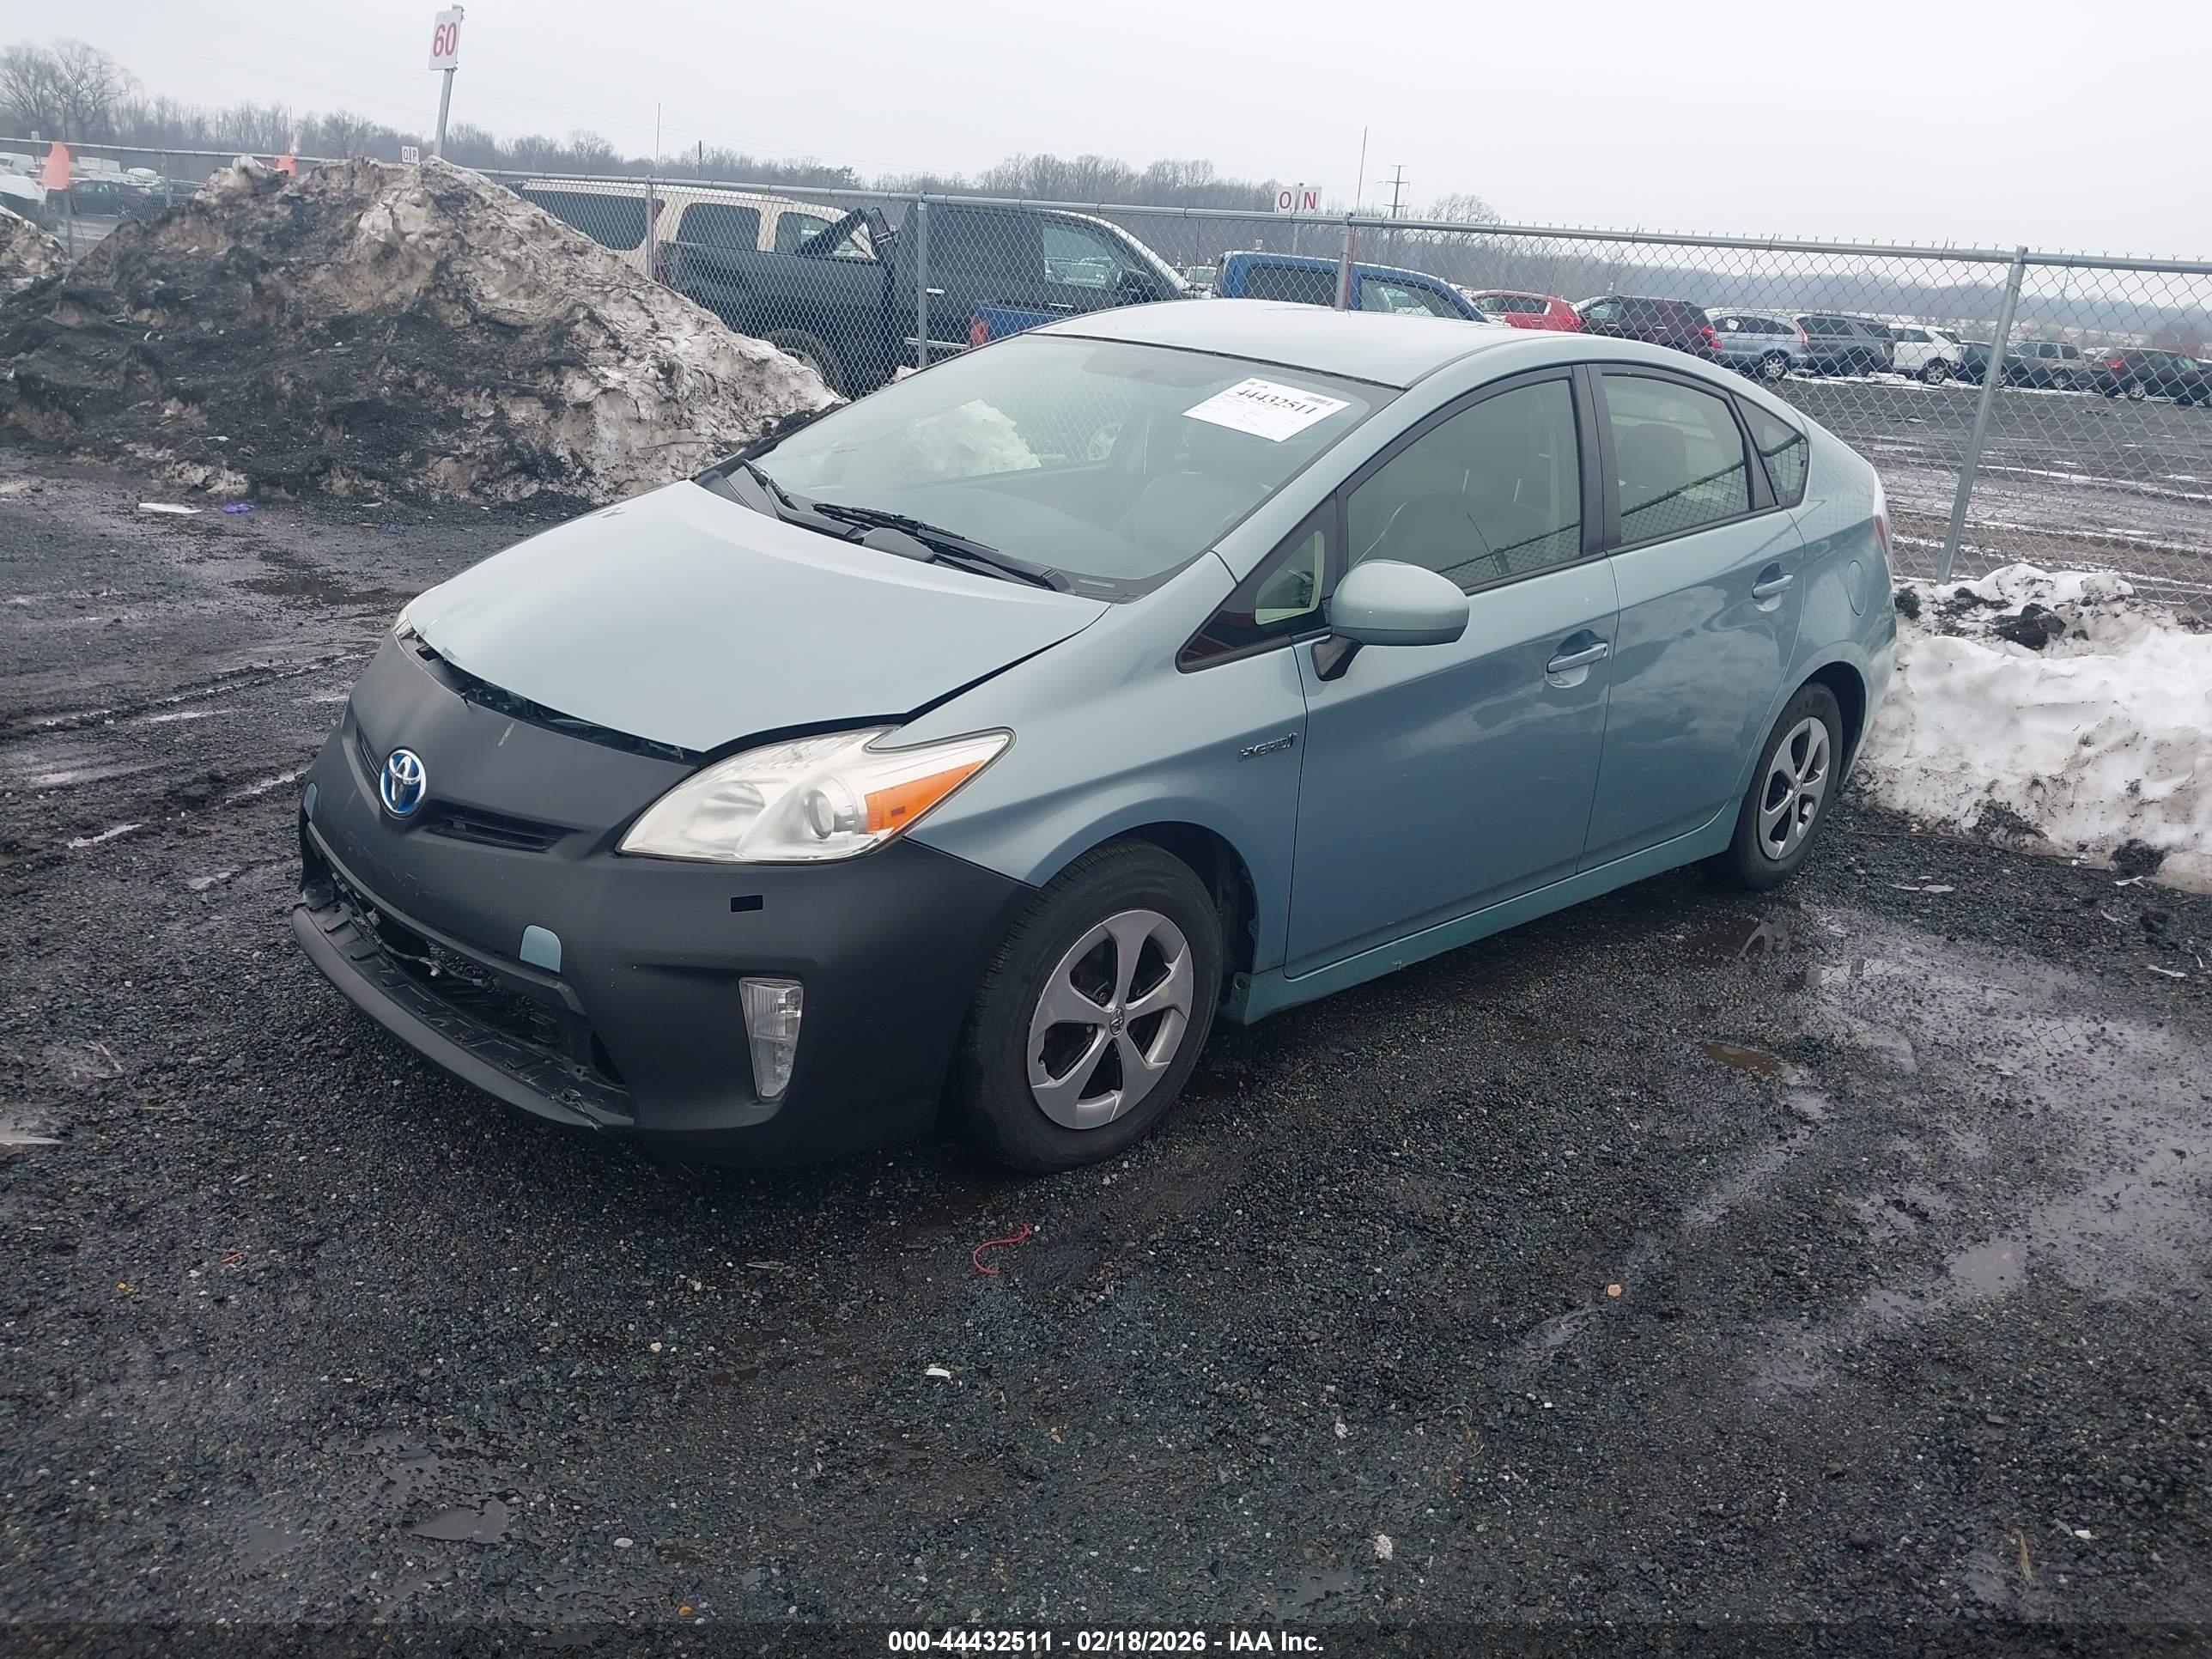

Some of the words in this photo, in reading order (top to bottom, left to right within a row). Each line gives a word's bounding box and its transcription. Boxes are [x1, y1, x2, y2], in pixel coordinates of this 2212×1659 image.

[433, 22, 457, 58] 60
[1303, 191, 1317, 210] N
[1237, 389, 1319, 415] 44432511
